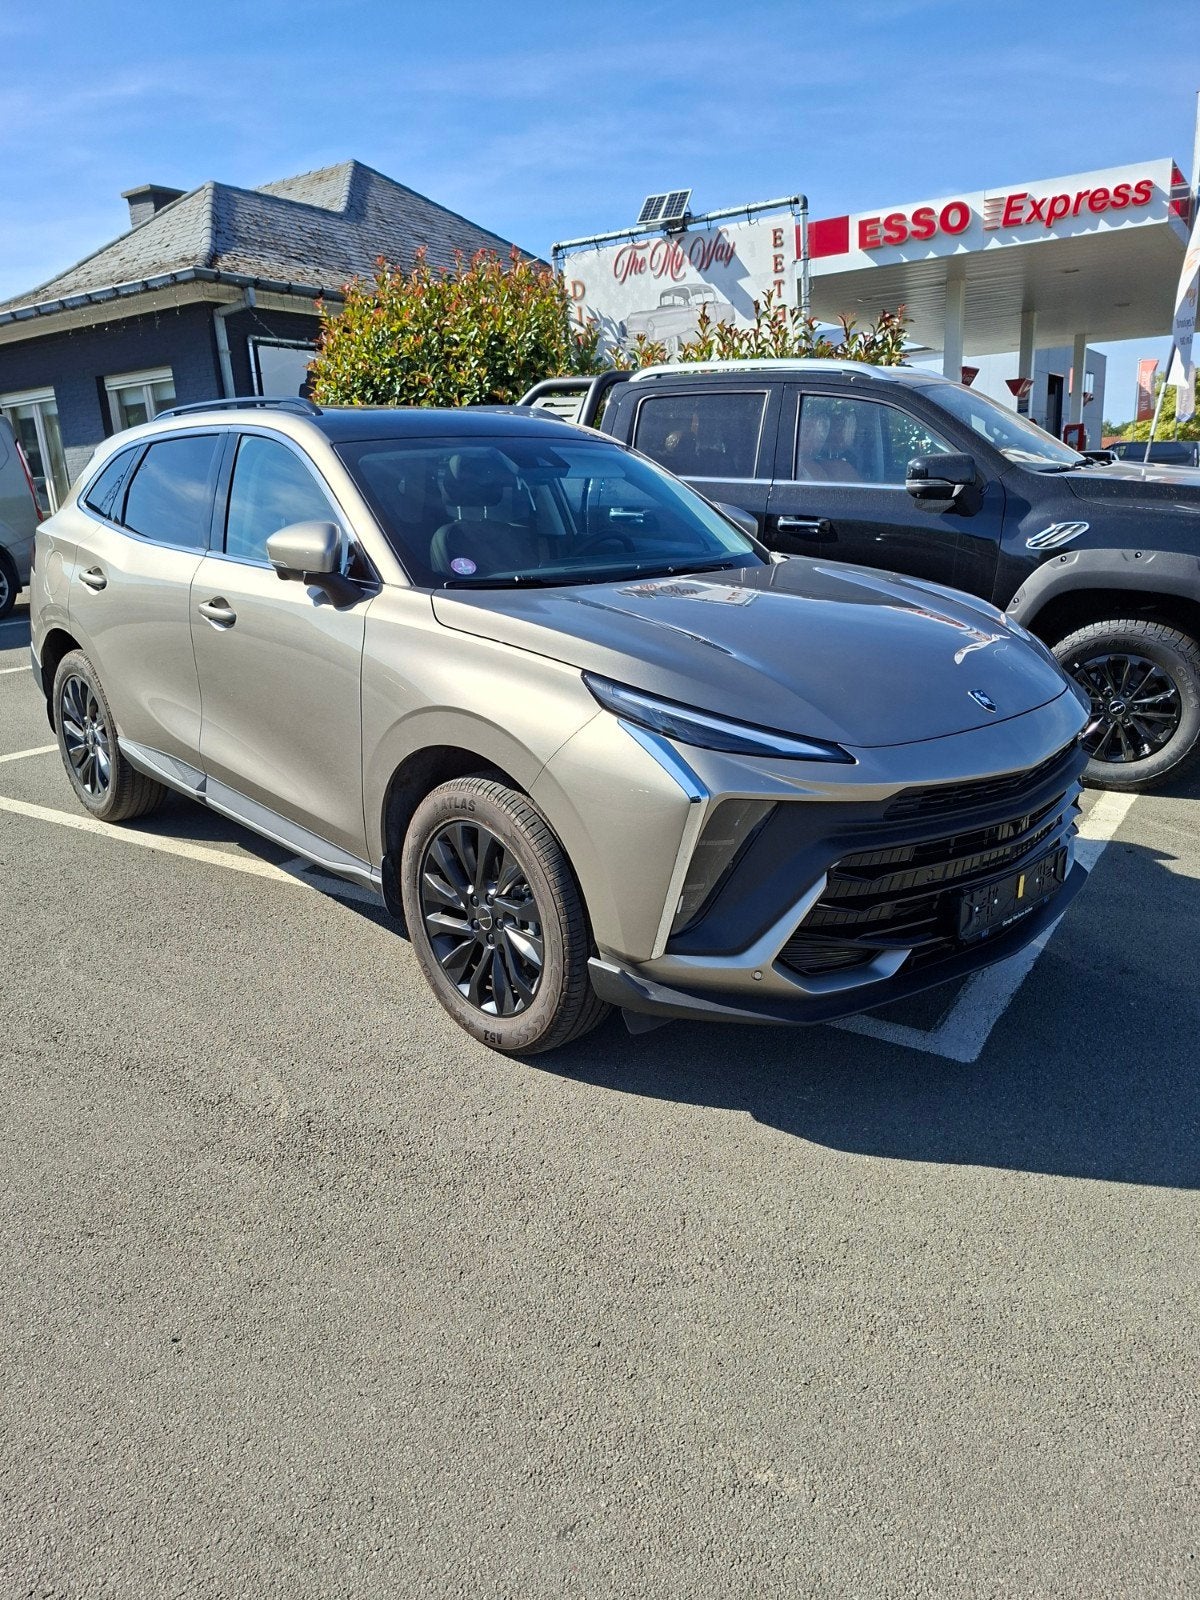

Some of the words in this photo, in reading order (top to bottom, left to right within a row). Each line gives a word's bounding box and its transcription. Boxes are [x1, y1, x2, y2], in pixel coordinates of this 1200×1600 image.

[858, 201, 972, 250] ESSO
[1002, 179, 1154, 227] Express
[613, 241, 649, 285] The
[650, 236, 687, 281] My
[689, 228, 736, 272] Way
[441, 796, 476, 812] ATLAS
[483, 1029, 503, 1044] A51
